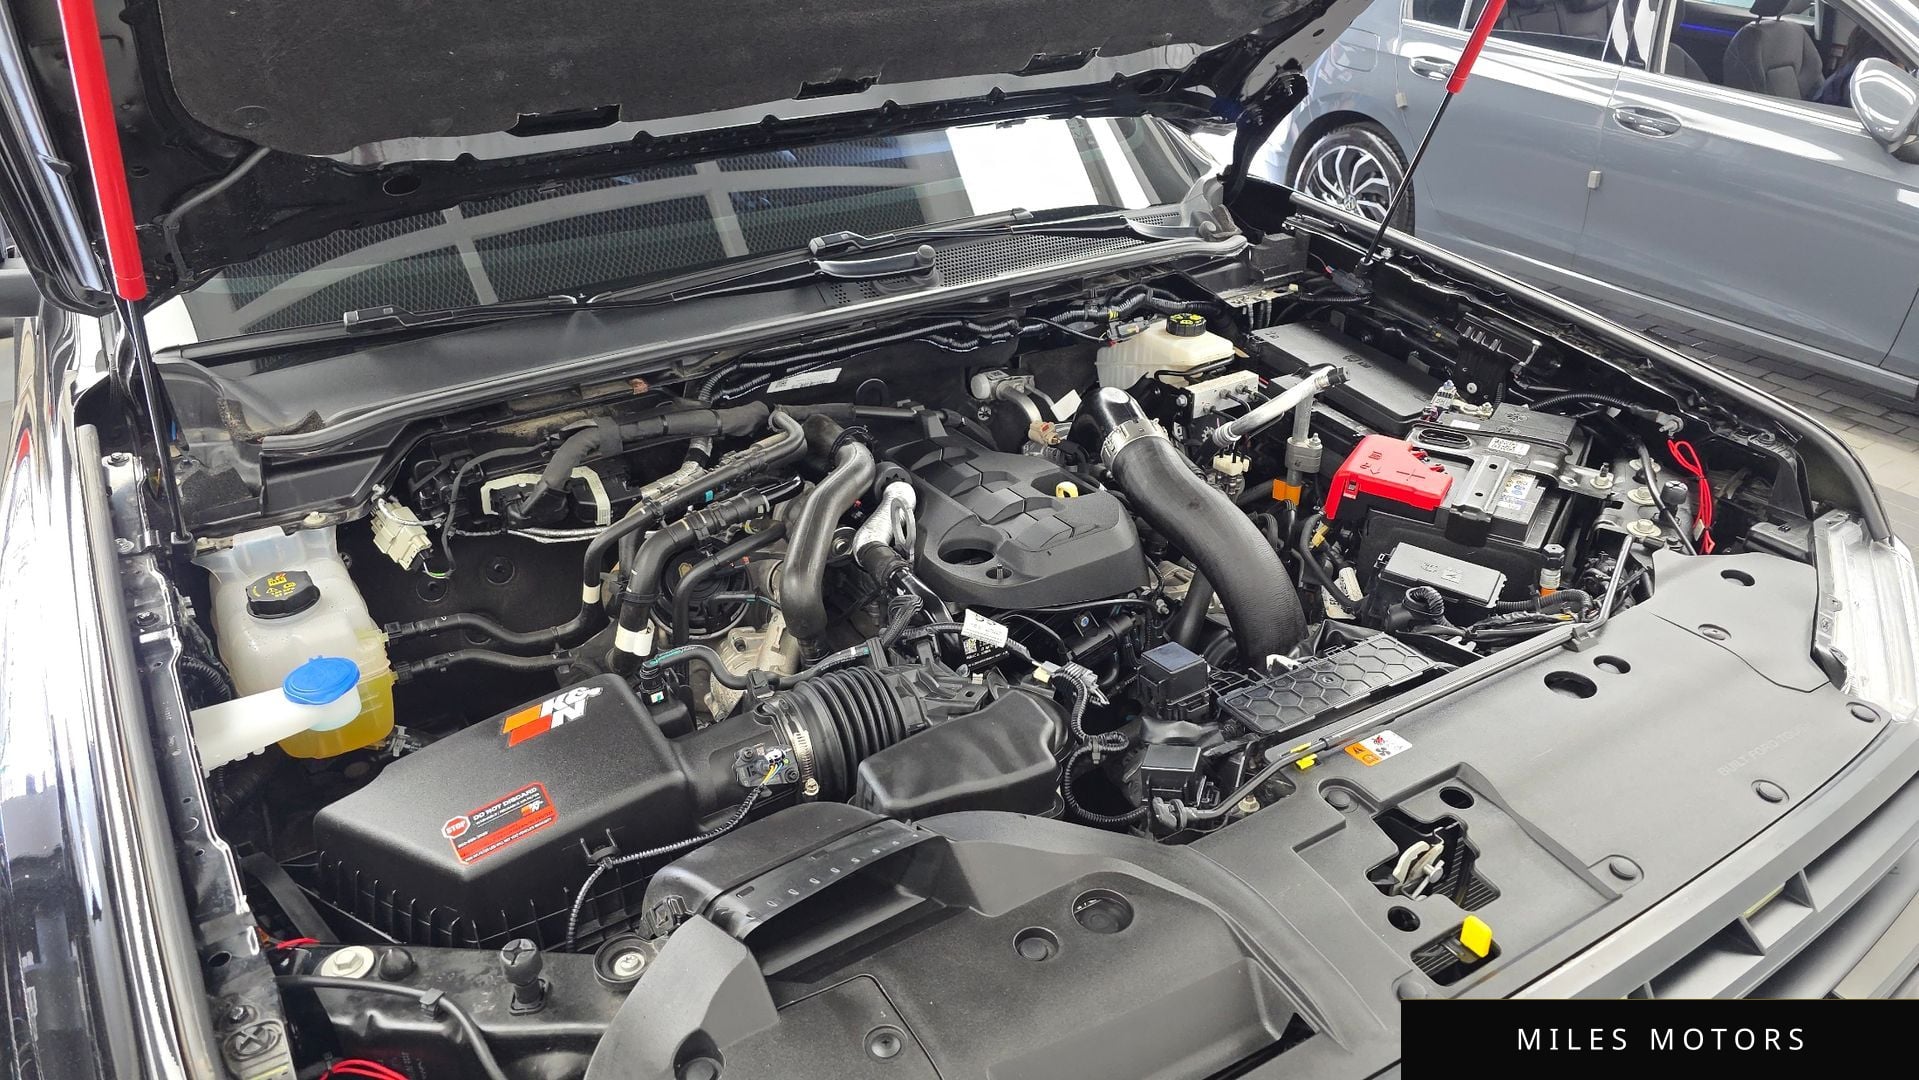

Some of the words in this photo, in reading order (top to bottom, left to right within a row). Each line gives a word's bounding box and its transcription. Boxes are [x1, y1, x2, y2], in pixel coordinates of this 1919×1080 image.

[540, 686, 604, 729] K&N
[1748, 739, 1780, 760] FORD
[473, 811, 486, 821] DO
[485, 803, 503, 815] NOT
[503, 787, 537, 807] DISCARD
[445, 820, 466, 835] STOP
